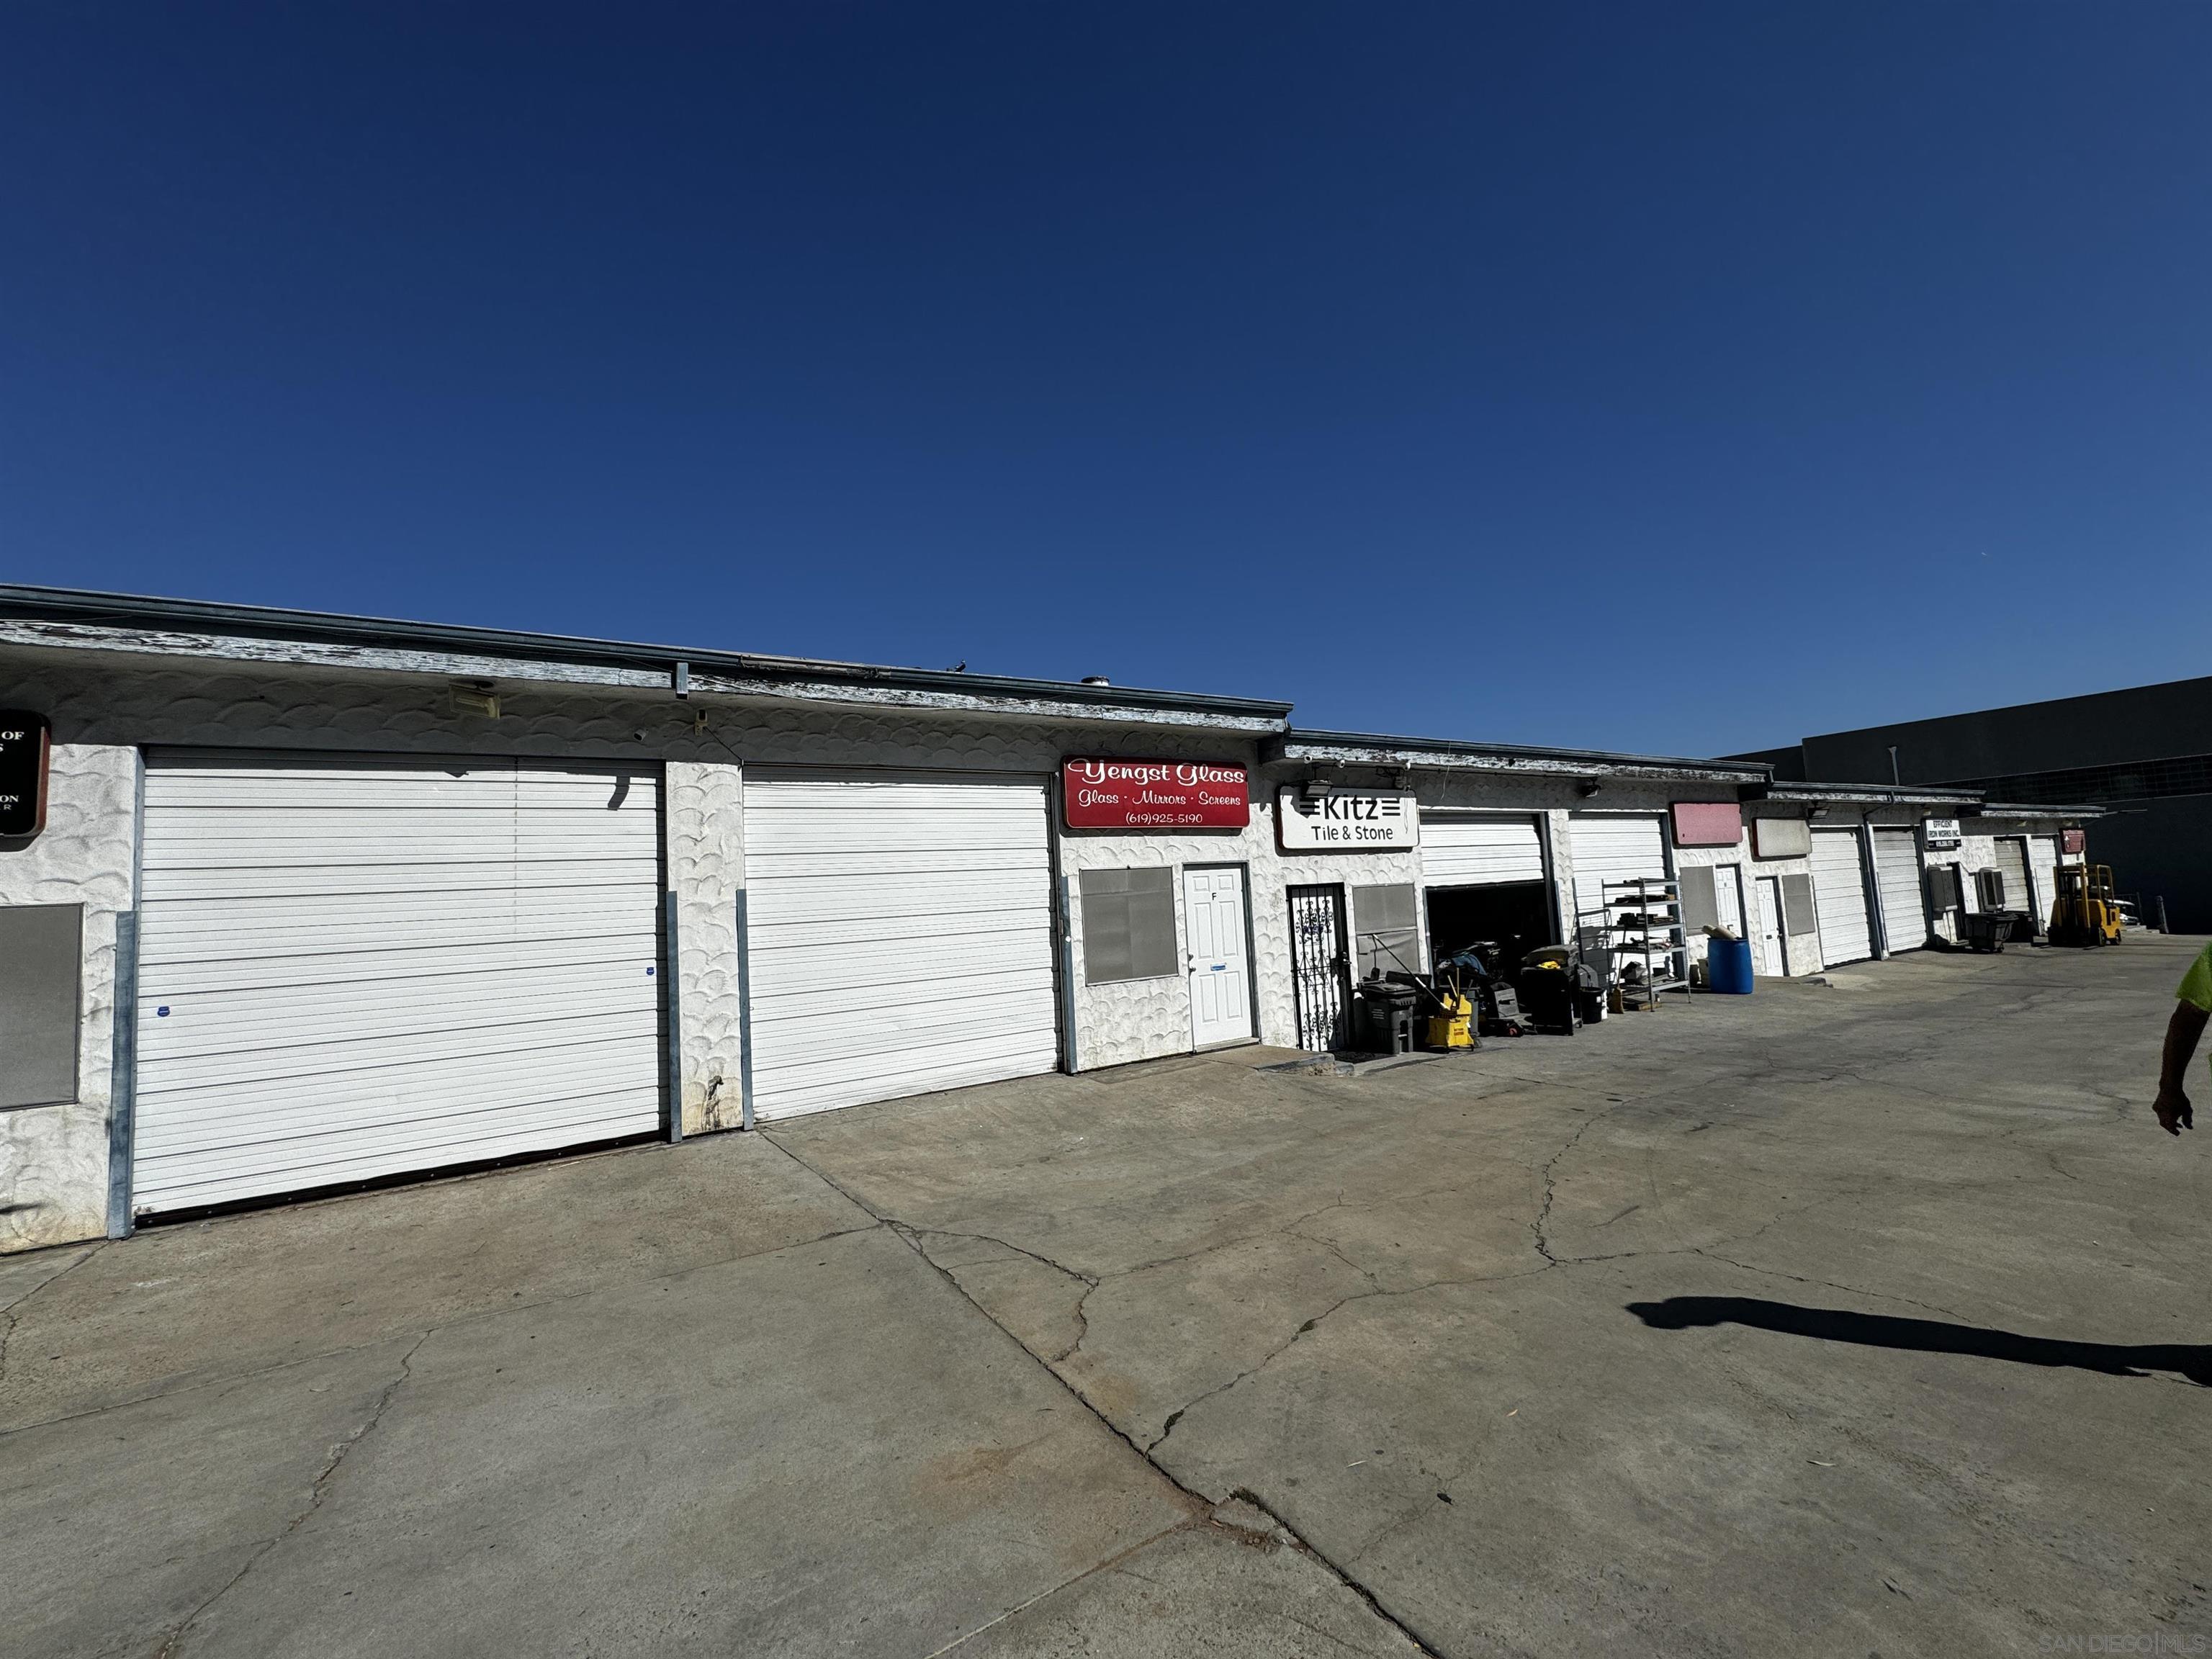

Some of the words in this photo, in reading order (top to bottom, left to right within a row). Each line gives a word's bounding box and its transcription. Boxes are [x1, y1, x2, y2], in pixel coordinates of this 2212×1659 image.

[1, 731, 24, 740] OF
[1068, 758, 1170, 786] Yengst
[1176, 763, 1244, 786] Glass
[1079, 789, 1119, 806] Glass
[1132, 790, 1186, 805] Mirrors
[1198, 791, 1241, 805] Screens
[1324, 794, 1378, 820] Kitz
[1125, 814, 1202, 825] (619)925-5190
[1311, 825, 1339, 840] Tile
[1342, 826, 1351, 840] &
[1356, 825, 1393, 840] Stone
